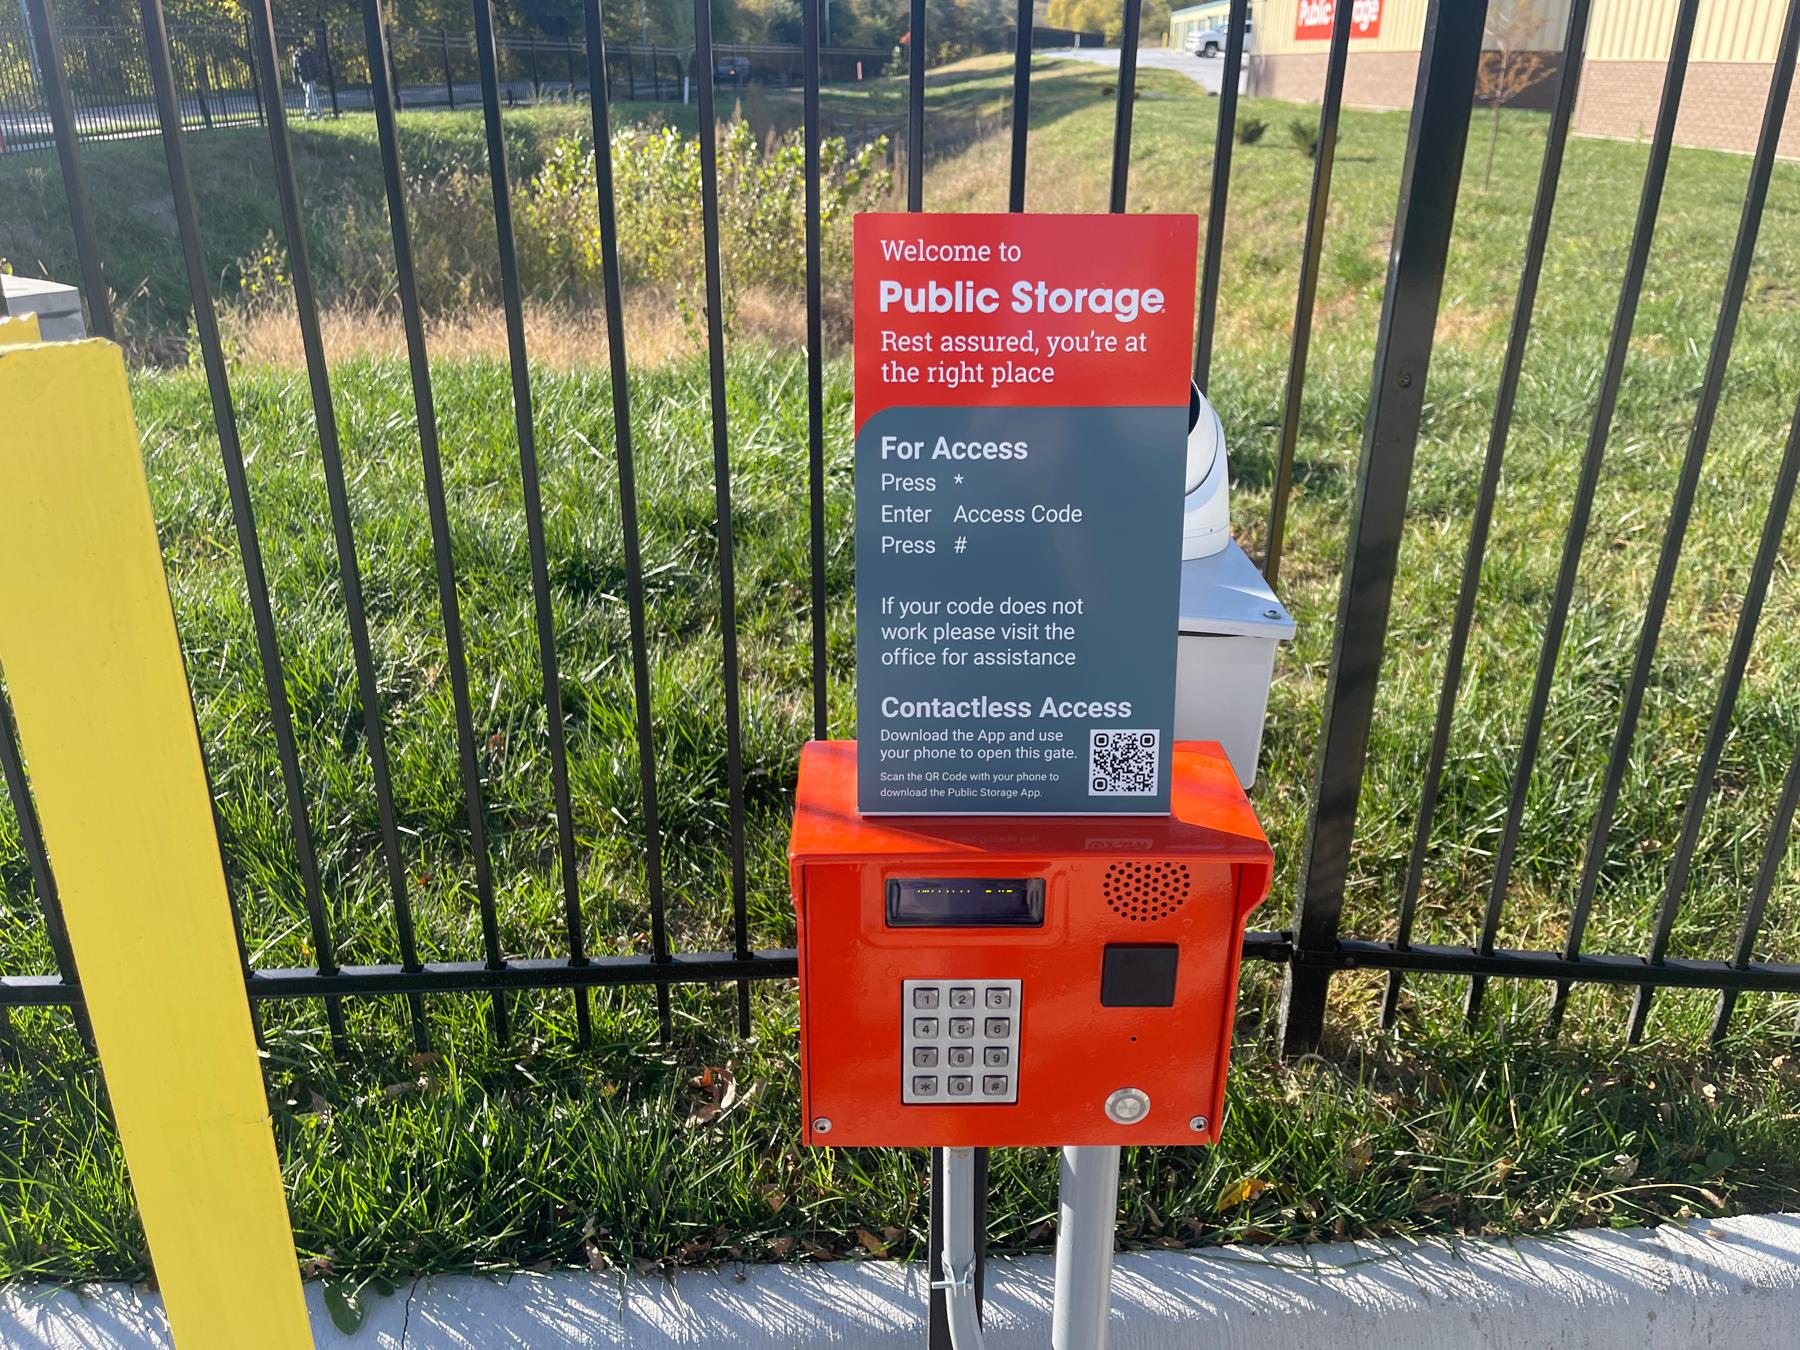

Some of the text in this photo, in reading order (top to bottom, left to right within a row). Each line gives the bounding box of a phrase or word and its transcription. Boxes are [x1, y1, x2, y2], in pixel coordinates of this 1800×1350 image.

[880, 238, 1022, 262] Welcome to
[879, 280, 1000, 314] Public
[880, 329, 1147, 358] Rest assured, you're at
[880, 360, 1055, 389] the right place
[881, 436, 1028, 460] For Access
[881, 473, 936, 492] Press
[881, 503, 1083, 524] Enter Access Code
[881, 536, 968, 554] Press #
[881, 596, 1084, 620] If your code does not
[881, 622, 1075, 645] work please visit the
[881, 647, 1076, 666] office for assistance
[881, 695, 1132, 718] Contactless Access
[880, 728, 1064, 746] Download the App and use
[880, 745, 1078, 763] your phone to open this gate.
[880, 771, 1059, 784] Scan the QR Code with your phone to
[879, 787, 1043, 800] download the Public Storage App.
[923, 995, 1003, 1005] 1 2 3
[922, 1025, 1002, 1035] 4 5 6
[921, 1053, 1001, 1064] 7 8 9
[956, 1082, 965, 1092] 0
[991, 1082, 1000, 1092] #
